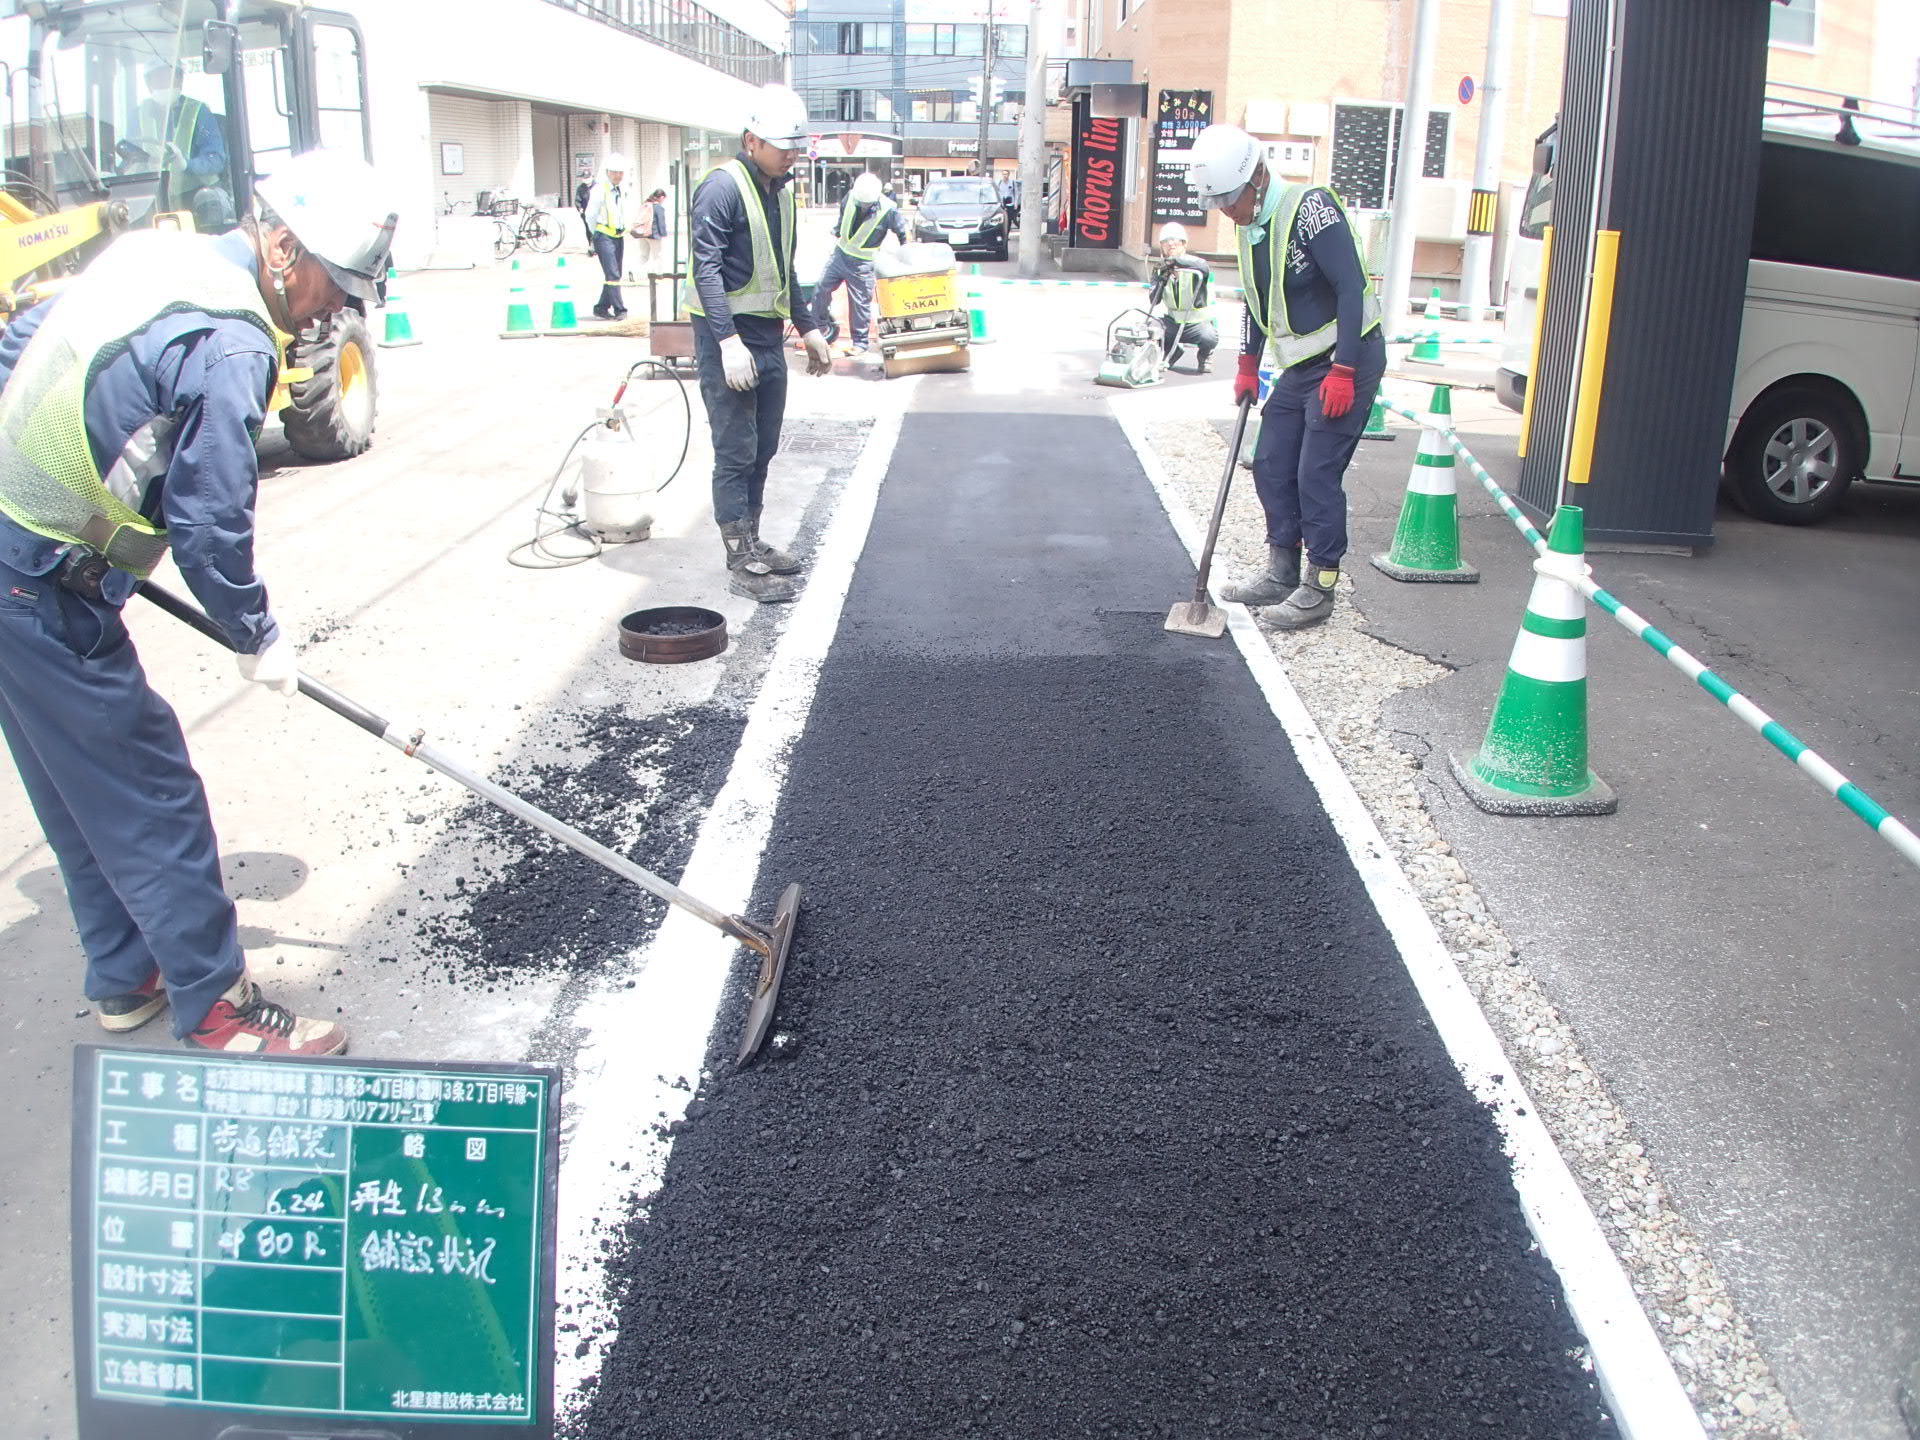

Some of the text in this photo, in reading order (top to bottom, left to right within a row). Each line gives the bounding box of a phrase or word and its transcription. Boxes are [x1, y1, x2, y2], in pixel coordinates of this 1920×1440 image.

[1077, 116, 1119, 241] chorus lin
[18, 223, 69, 248] KOMATSU
[1305, 206, 1341, 240] TIER
[904, 299, 939, 310] SAKAI
[104, 1167, 194, 1200] 撮影月日
[266, 1188, 325, 1215] 6.24
[102, 1263, 193, 1297] 設計寸法
[102, 1311, 193, 1345] 実測寸法
[104, 1358, 194, 1391] 立会監督員
[392, 1390, 525, 1411] 北星建設株式会社
